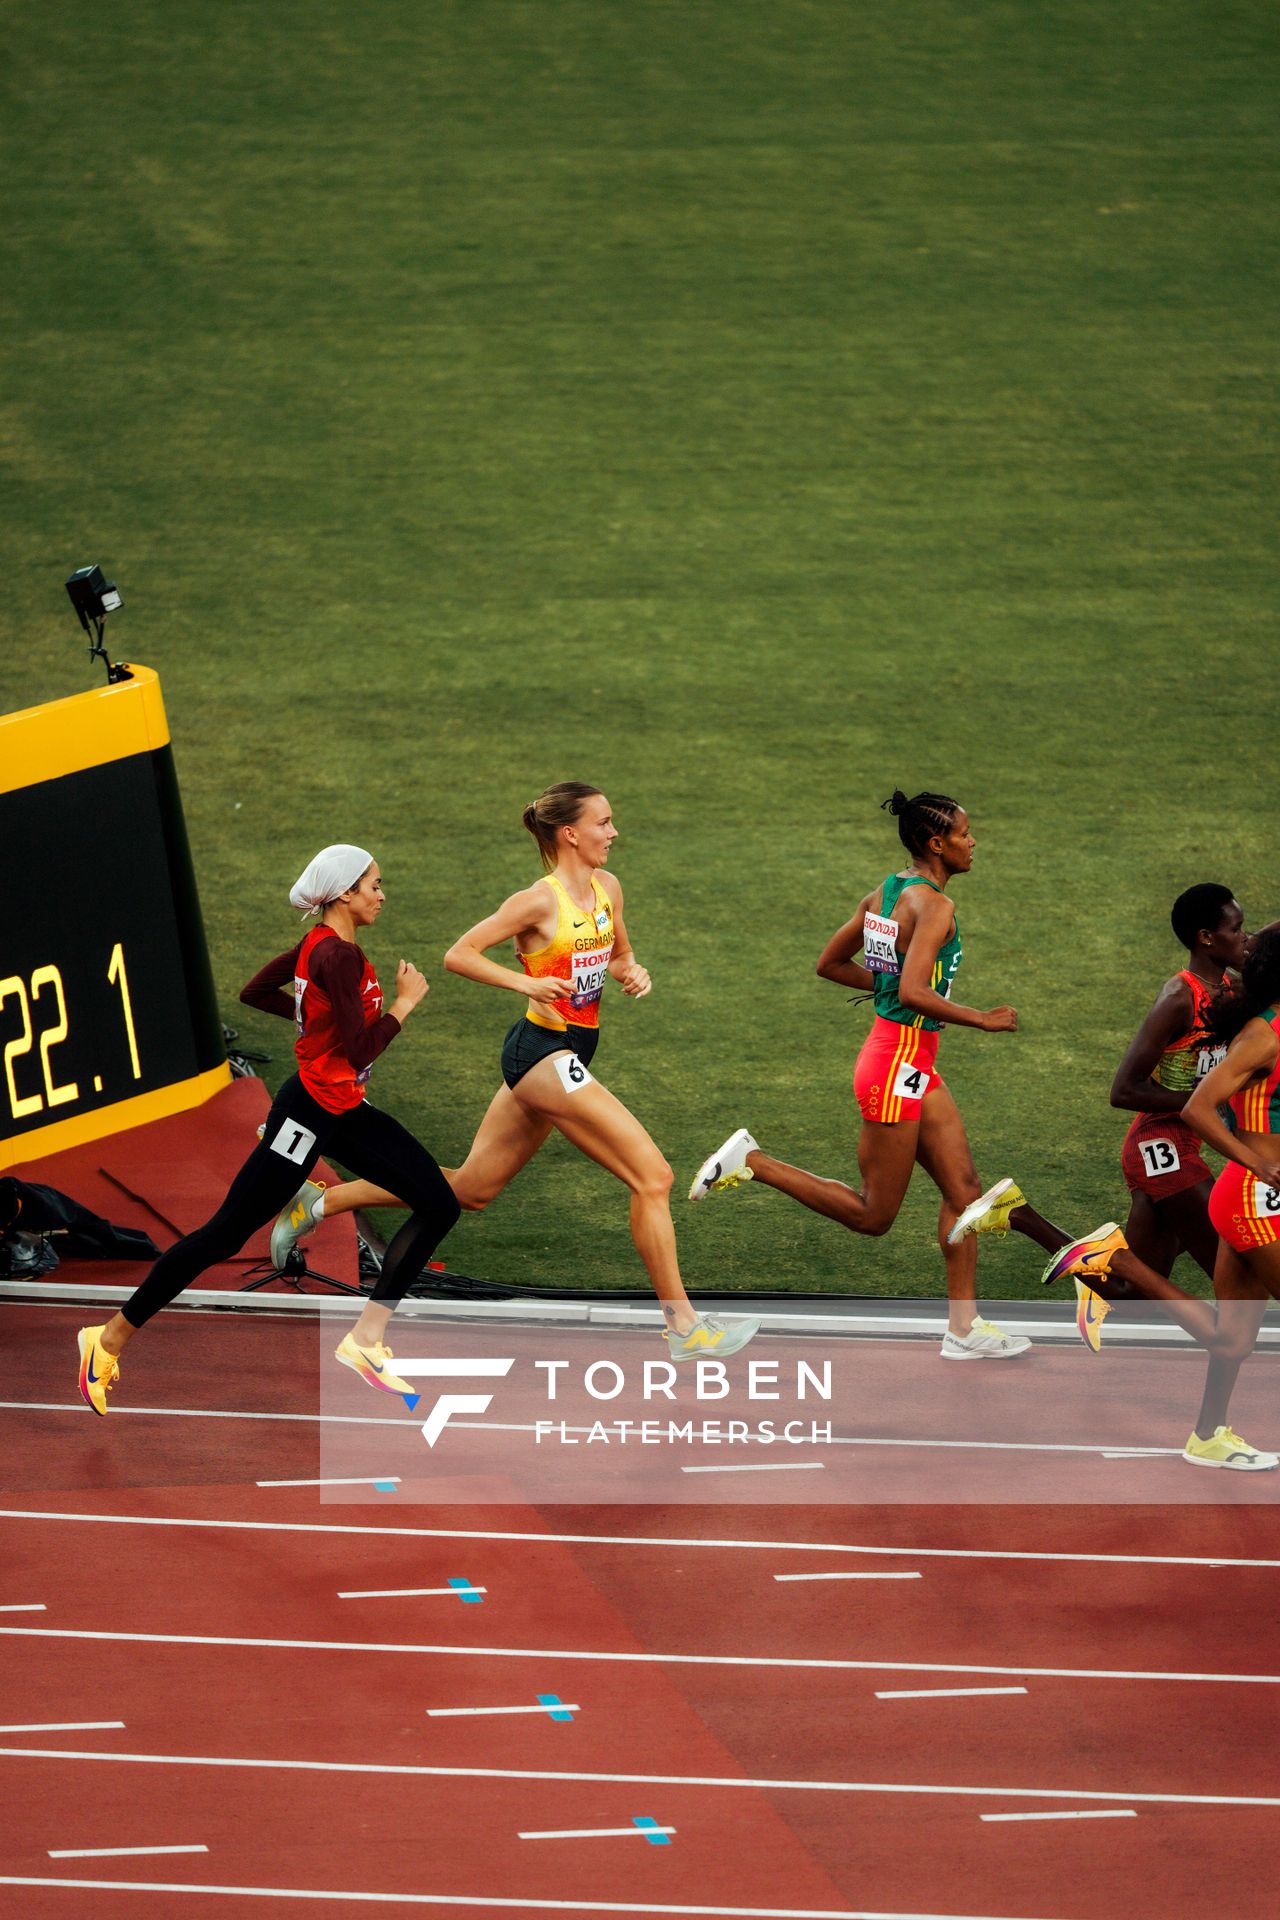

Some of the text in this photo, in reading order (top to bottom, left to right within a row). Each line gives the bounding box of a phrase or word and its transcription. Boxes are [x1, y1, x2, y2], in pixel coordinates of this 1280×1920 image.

[864, 917, 896, 937] HONDA
[574, 932, 613, 951] GERMAN
[864, 934, 894, 960] ULETA
[574, 951, 610, 968] HOND
[577, 968, 607, 992] MEYE
[0, 942, 141, 1119] 22.1
[569, 1058, 584, 1083] 6
[904, 1071, 921, 1094] 4
[287, 1130, 304, 1155] 1
[1145, 1142, 1175, 1170] 13
[1266, 1188, 1280, 1211] 8
